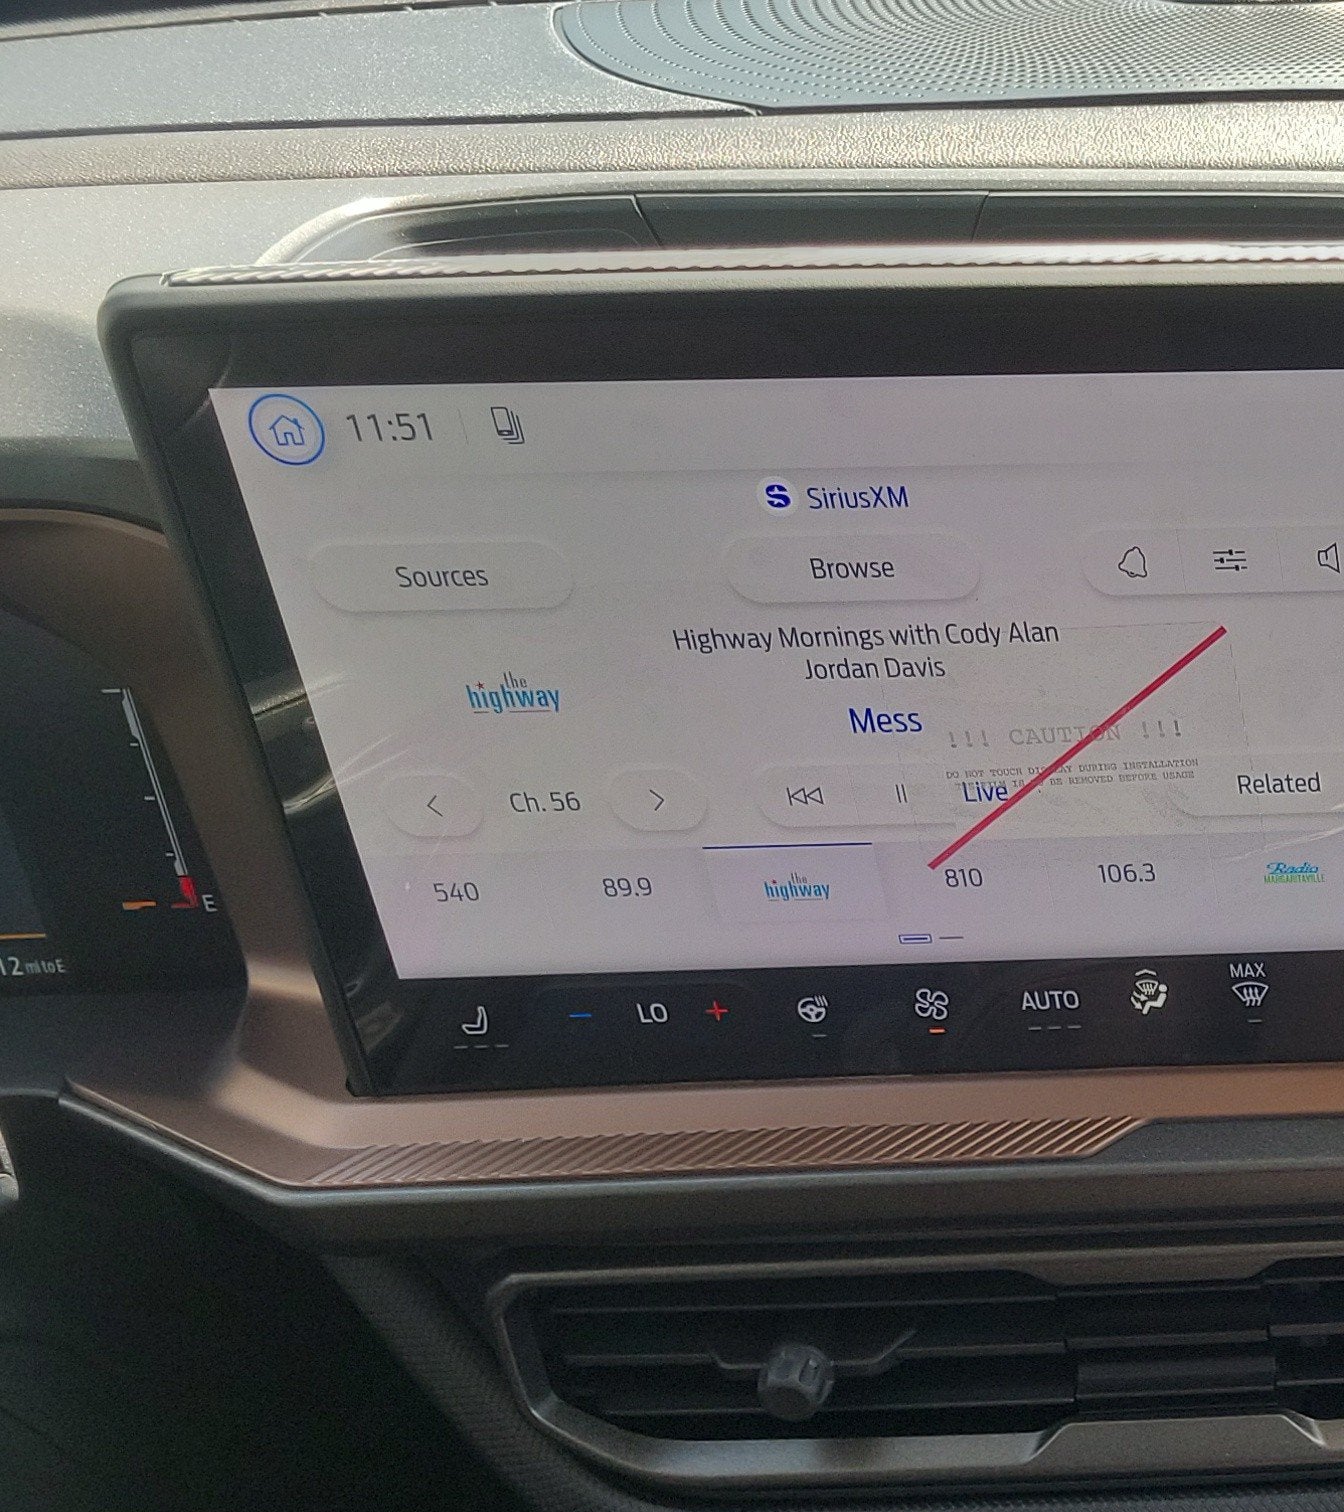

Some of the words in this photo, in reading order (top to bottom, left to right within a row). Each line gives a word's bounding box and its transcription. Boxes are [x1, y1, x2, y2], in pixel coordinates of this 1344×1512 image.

[345, 412, 435, 444] 11:51
[807, 485, 909, 510] SiriusXM
[394, 564, 490, 588] Sources
[809, 556, 896, 581] Browse
[673, 627, 773, 654] Highway
[778, 625, 885, 651] Mornings
[889, 622, 940, 646] with
[945, 621, 1001, 648] Cody
[1008, 620, 1060, 643] Alan
[805, 657, 880, 680] Jordan
[884, 656, 946, 679] Davis
[503, 671, 528, 689] the
[466, 683, 559, 714] highway
[849, 706, 924, 734] Mess
[1008, 723, 1122, 747] CAUTION
[946, 770, 959, 779] DO
[965, 769, 985, 779] NOT
[990, 767, 1023, 777] TOUCH
[1079, 762, 1118, 773] DURING
[1123, 758, 1199, 770] INSTALLATION
[1069, 774, 1114, 785] REMOVED
[1119, 772, 1158, 783] BEFORE
[1163, 770, 1195, 780] USAGE
[962, 780, 1009, 803] Live
[1237, 771, 1322, 796] Related
[509, 791, 546, 814] Ch.
[549, 790, 581, 812] 56
[944, 867, 983, 888] 810
[1097, 862, 1156, 884] 106.3
[1266, 861, 1319, 875] Radio
[433, 880, 479, 903] 540
[602, 876, 652, 898] 89.9
[764, 879, 831, 901] highway
[202, 894, 217, 912] E
[1229, 962, 1266, 979] MAX
[1021, 988, 1080, 1012] AUTO
[637, 1002, 668, 1024] LO
